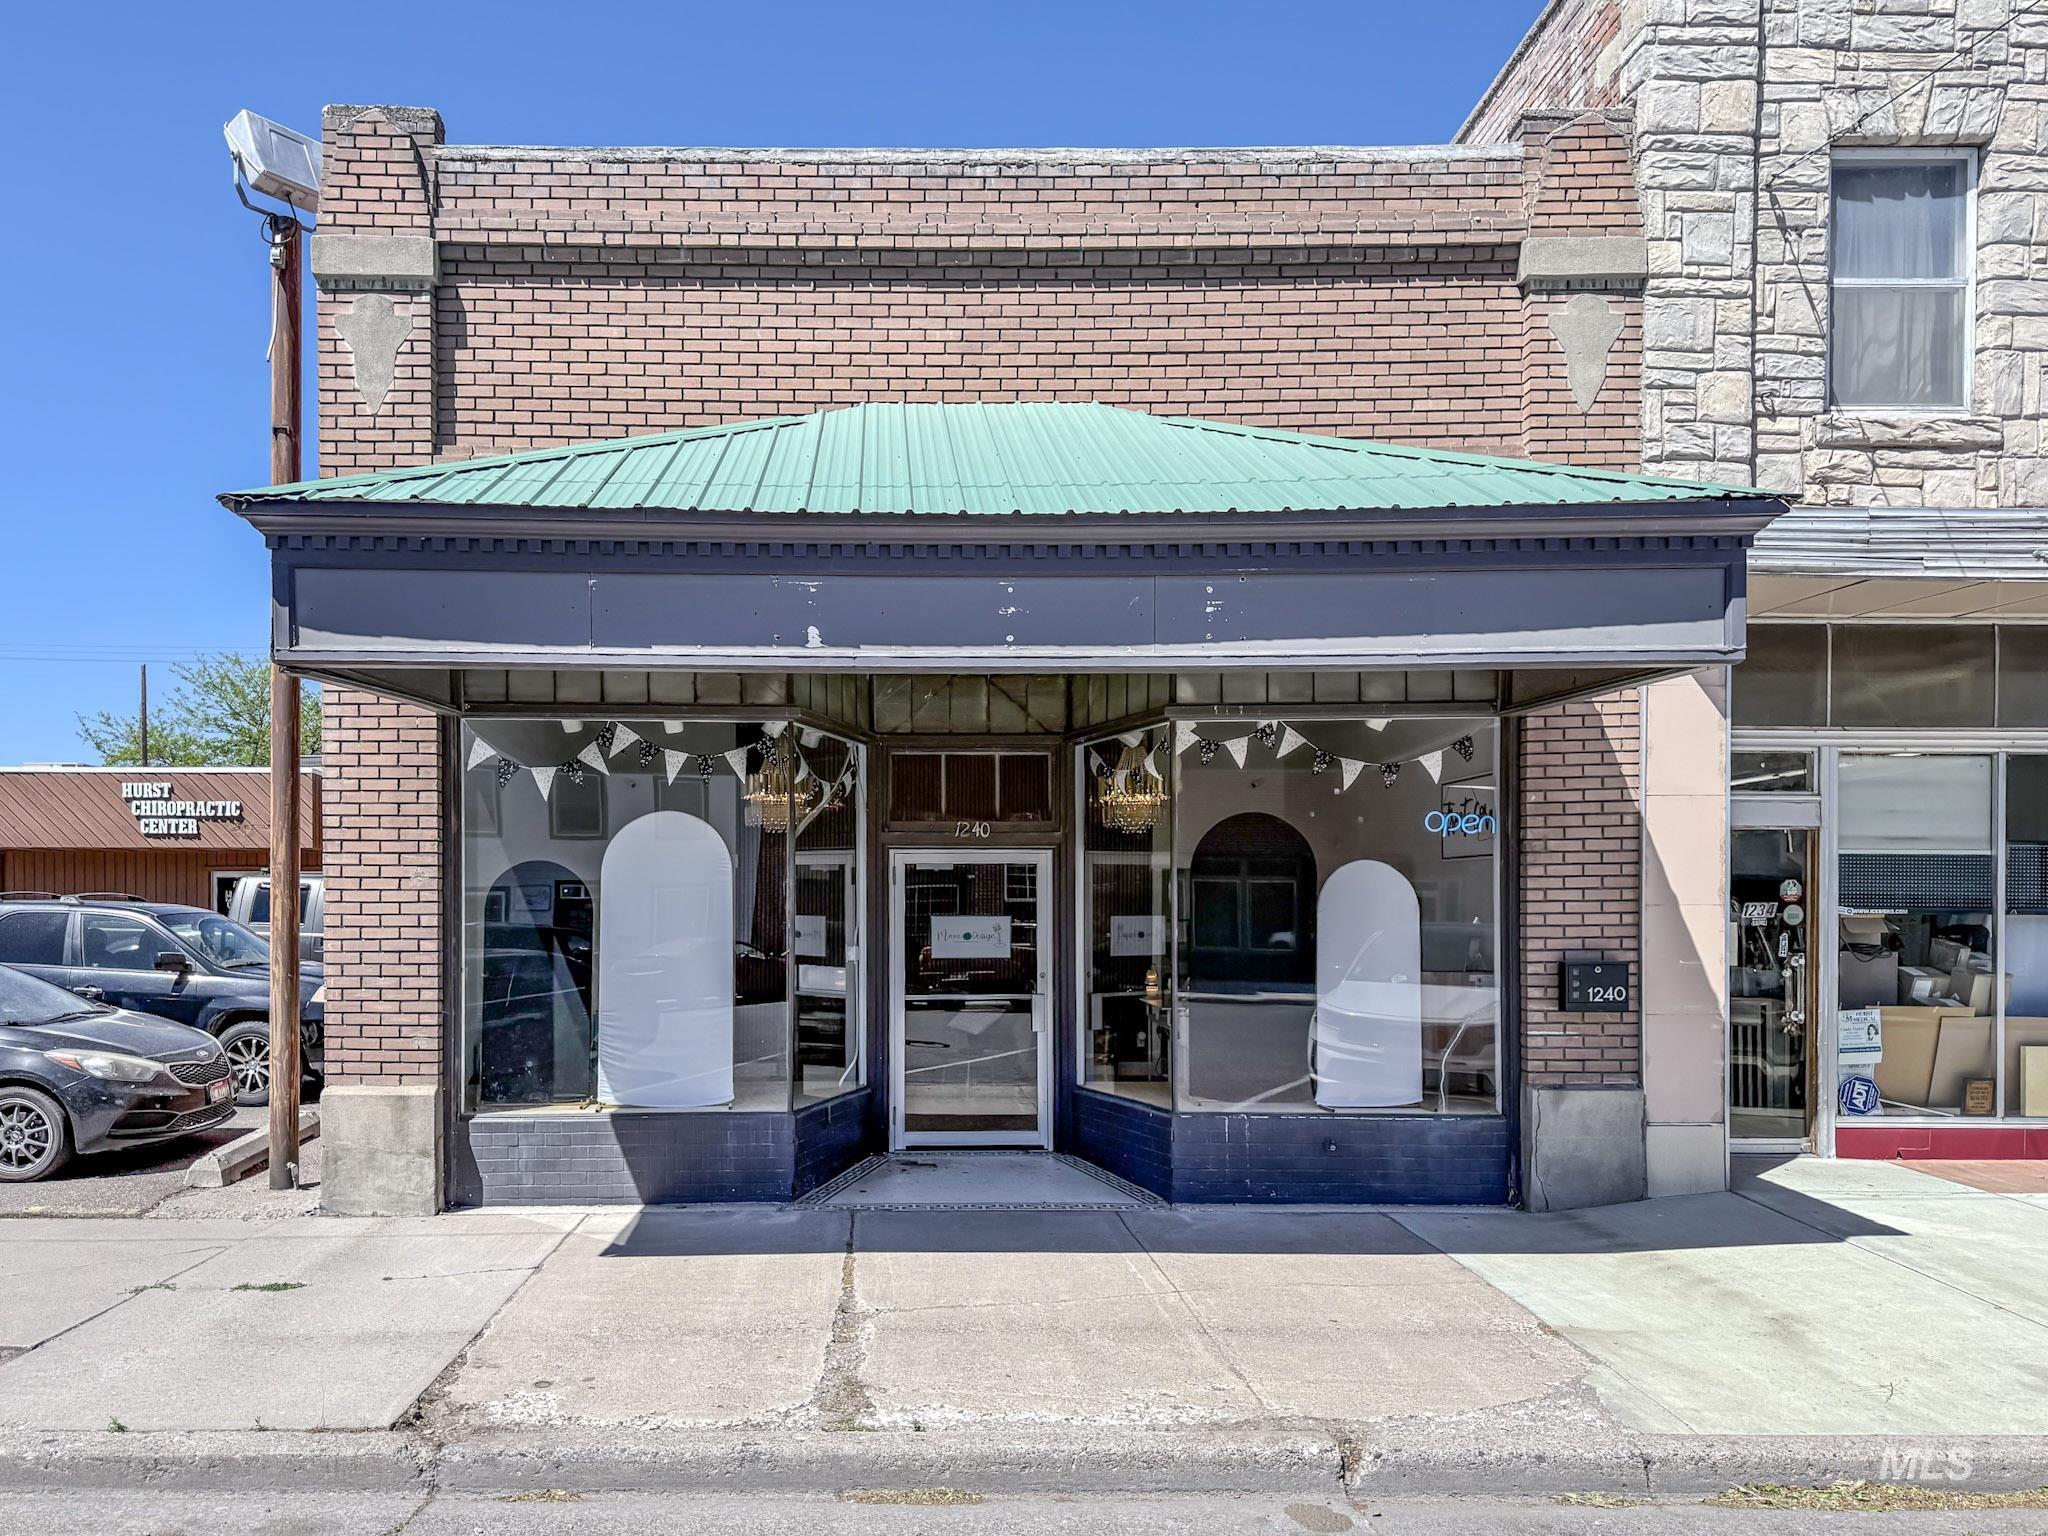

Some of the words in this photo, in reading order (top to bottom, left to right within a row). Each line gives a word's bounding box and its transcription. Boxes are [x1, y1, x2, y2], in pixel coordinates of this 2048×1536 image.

[121, 782, 171, 798] HURST
[131, 800, 241, 816] CHIROPRACTIC
[140, 818, 198, 834] CENTER
[954, 821, 991, 838] 1240
[1424, 810, 1496, 838] open
[1743, 903, 1776, 918] 1234
[1587, 985, 1627, 1002] 1240
[1851, 1080, 1870, 1111] ADT
